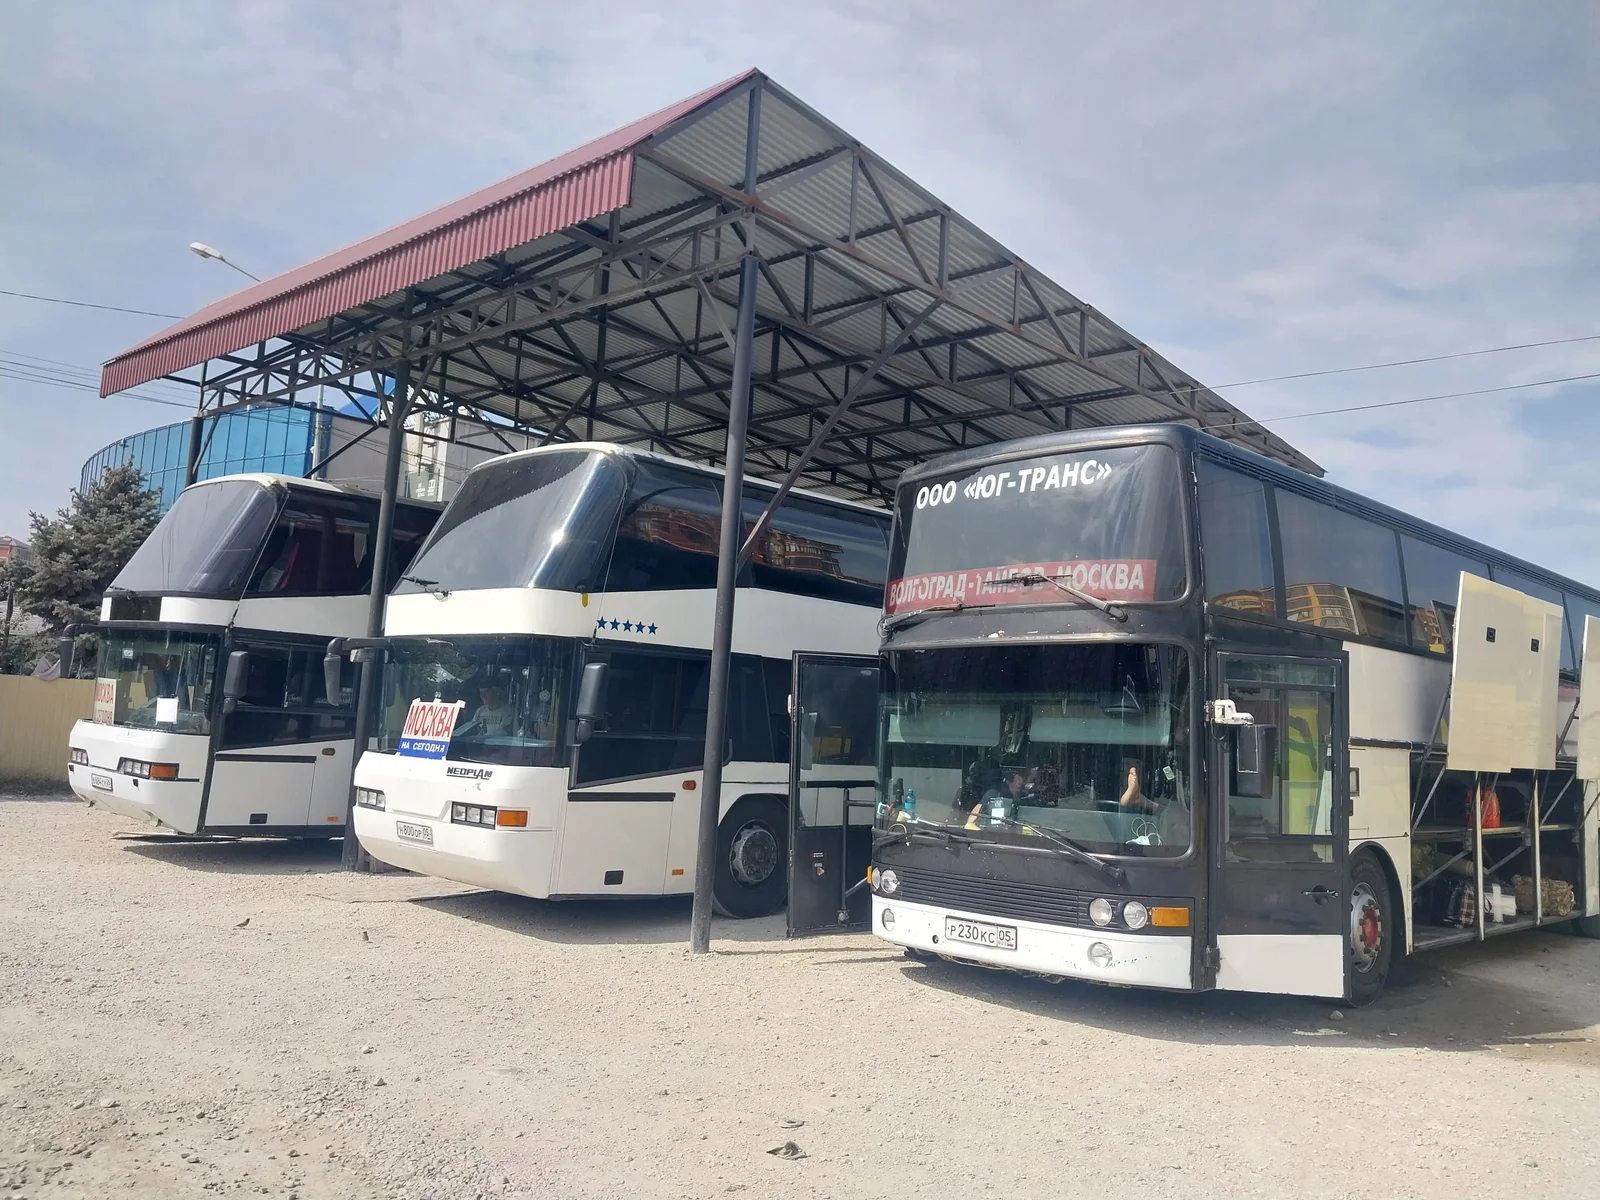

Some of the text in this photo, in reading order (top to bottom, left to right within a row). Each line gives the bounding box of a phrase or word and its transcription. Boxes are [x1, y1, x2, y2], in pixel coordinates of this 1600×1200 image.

[916, 460, 1112, 510] ООО «ЮГ-ТРАНС»
[404, 705, 455, 737] МОСКВА
[401, 741, 446, 753] НА СЕГОДНЯ
[446, 766, 493, 780] NEOPLAN
[998, 930, 1011, 942] 05
